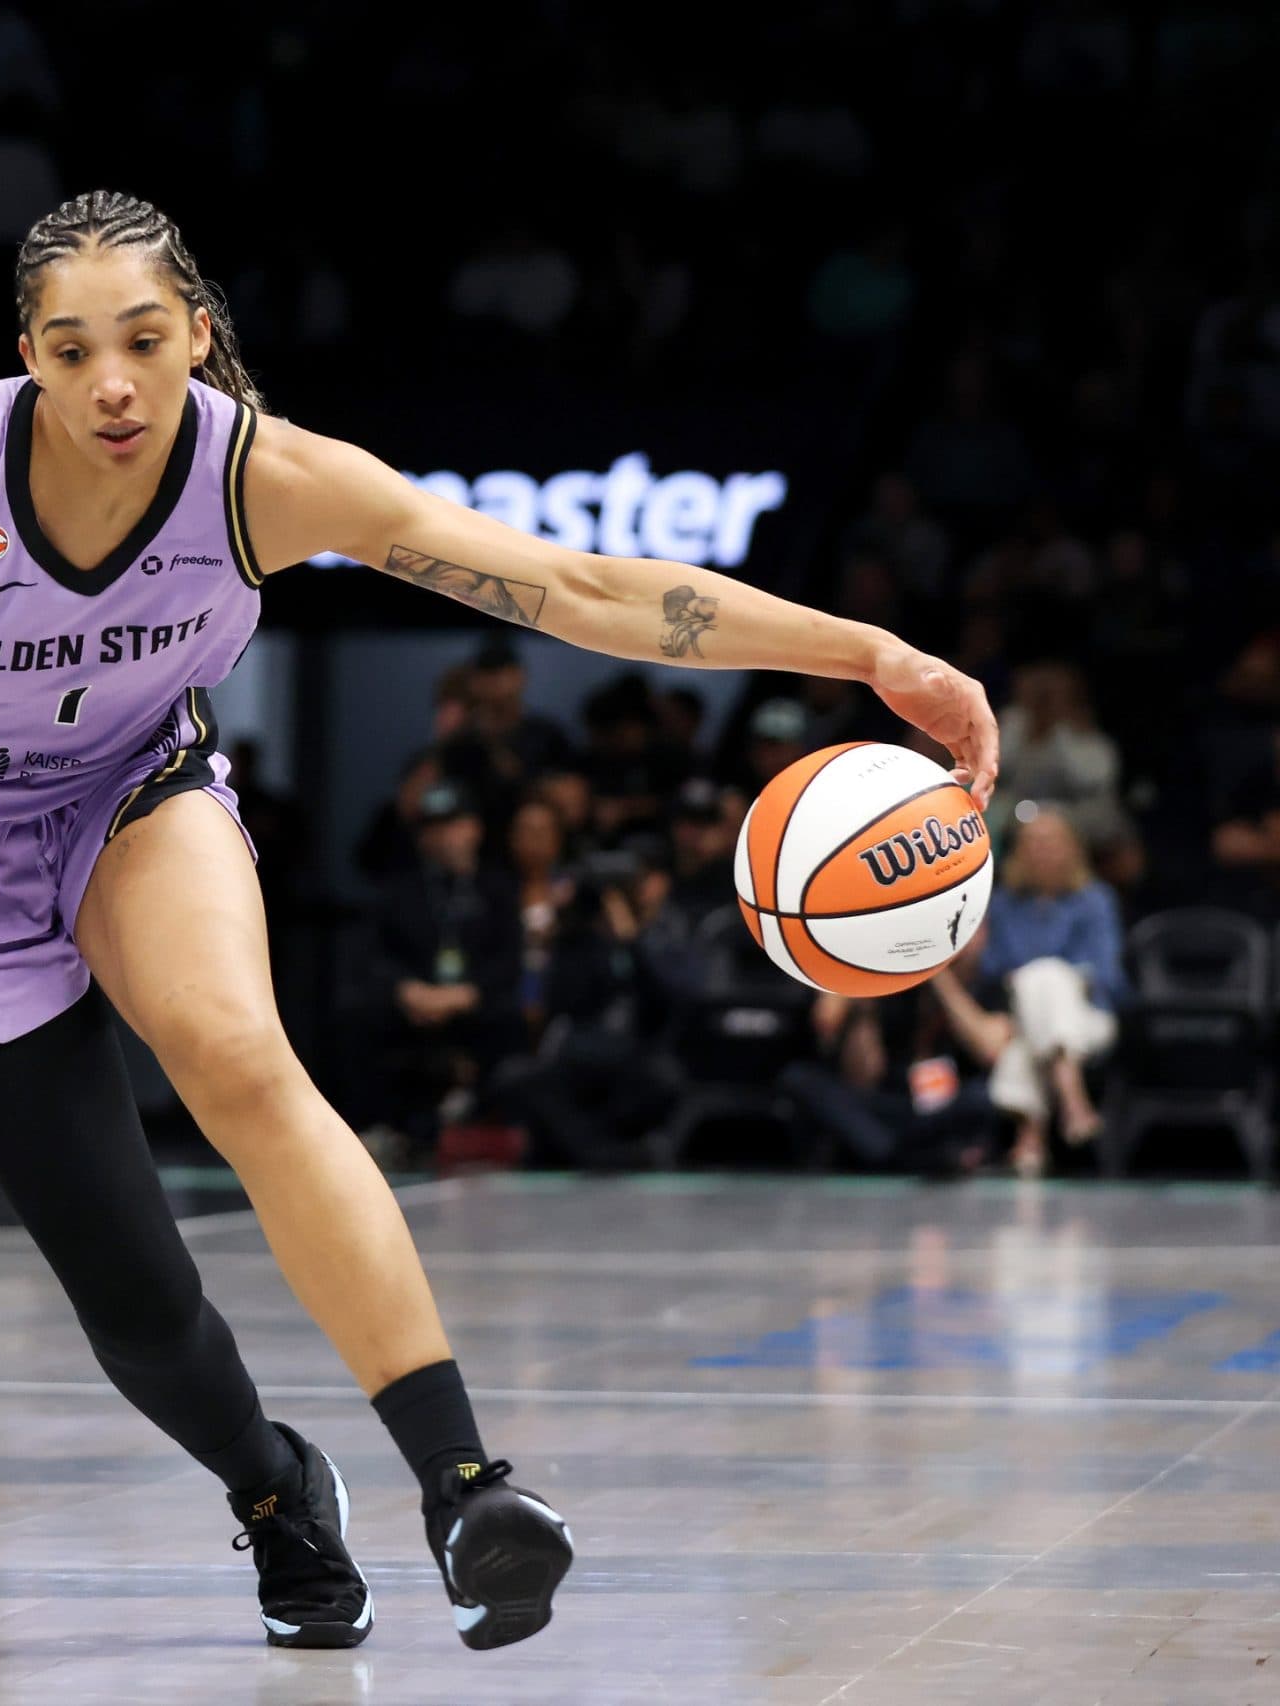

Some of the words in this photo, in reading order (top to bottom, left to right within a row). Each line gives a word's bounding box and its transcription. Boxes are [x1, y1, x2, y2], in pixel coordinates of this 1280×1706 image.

[169, 554, 224, 572] freedom
[99, 607, 213, 664] STATE
[54, 685, 94, 727] 1
[859, 811, 985, 885] Wilson
